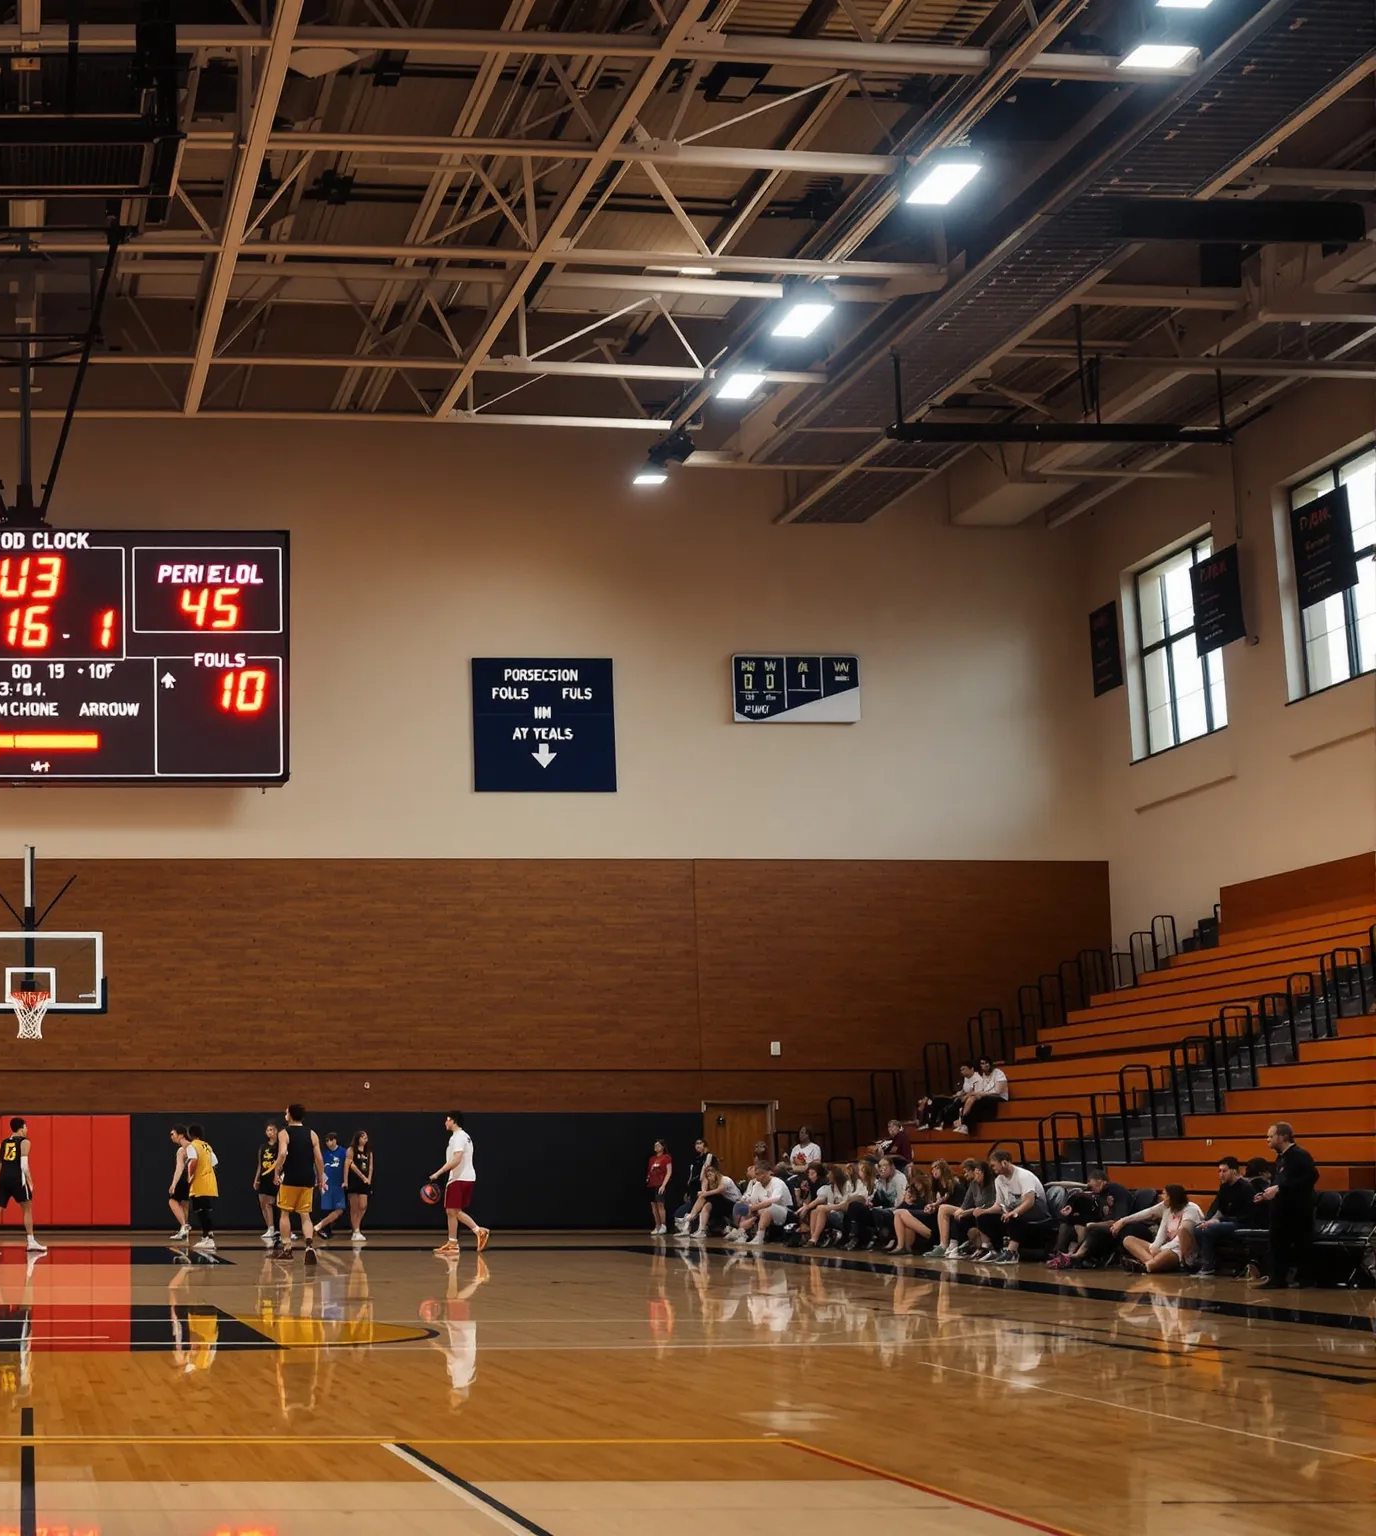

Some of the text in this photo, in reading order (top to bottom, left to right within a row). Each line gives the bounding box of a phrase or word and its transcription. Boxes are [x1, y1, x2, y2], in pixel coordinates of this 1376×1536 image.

[32, 532, 90, 549] CLOCK
[181, 588, 240, 628] 45
[7, 605, 50, 647] 16
[101, 610, 114, 648] 1
[194, 652, 246, 668] FOULS
[11, 663, 32, 679] 00
[221, 670, 266, 711] 10
[562, 687, 593, 700] FULS
[79, 702, 140, 716] ARROUW
